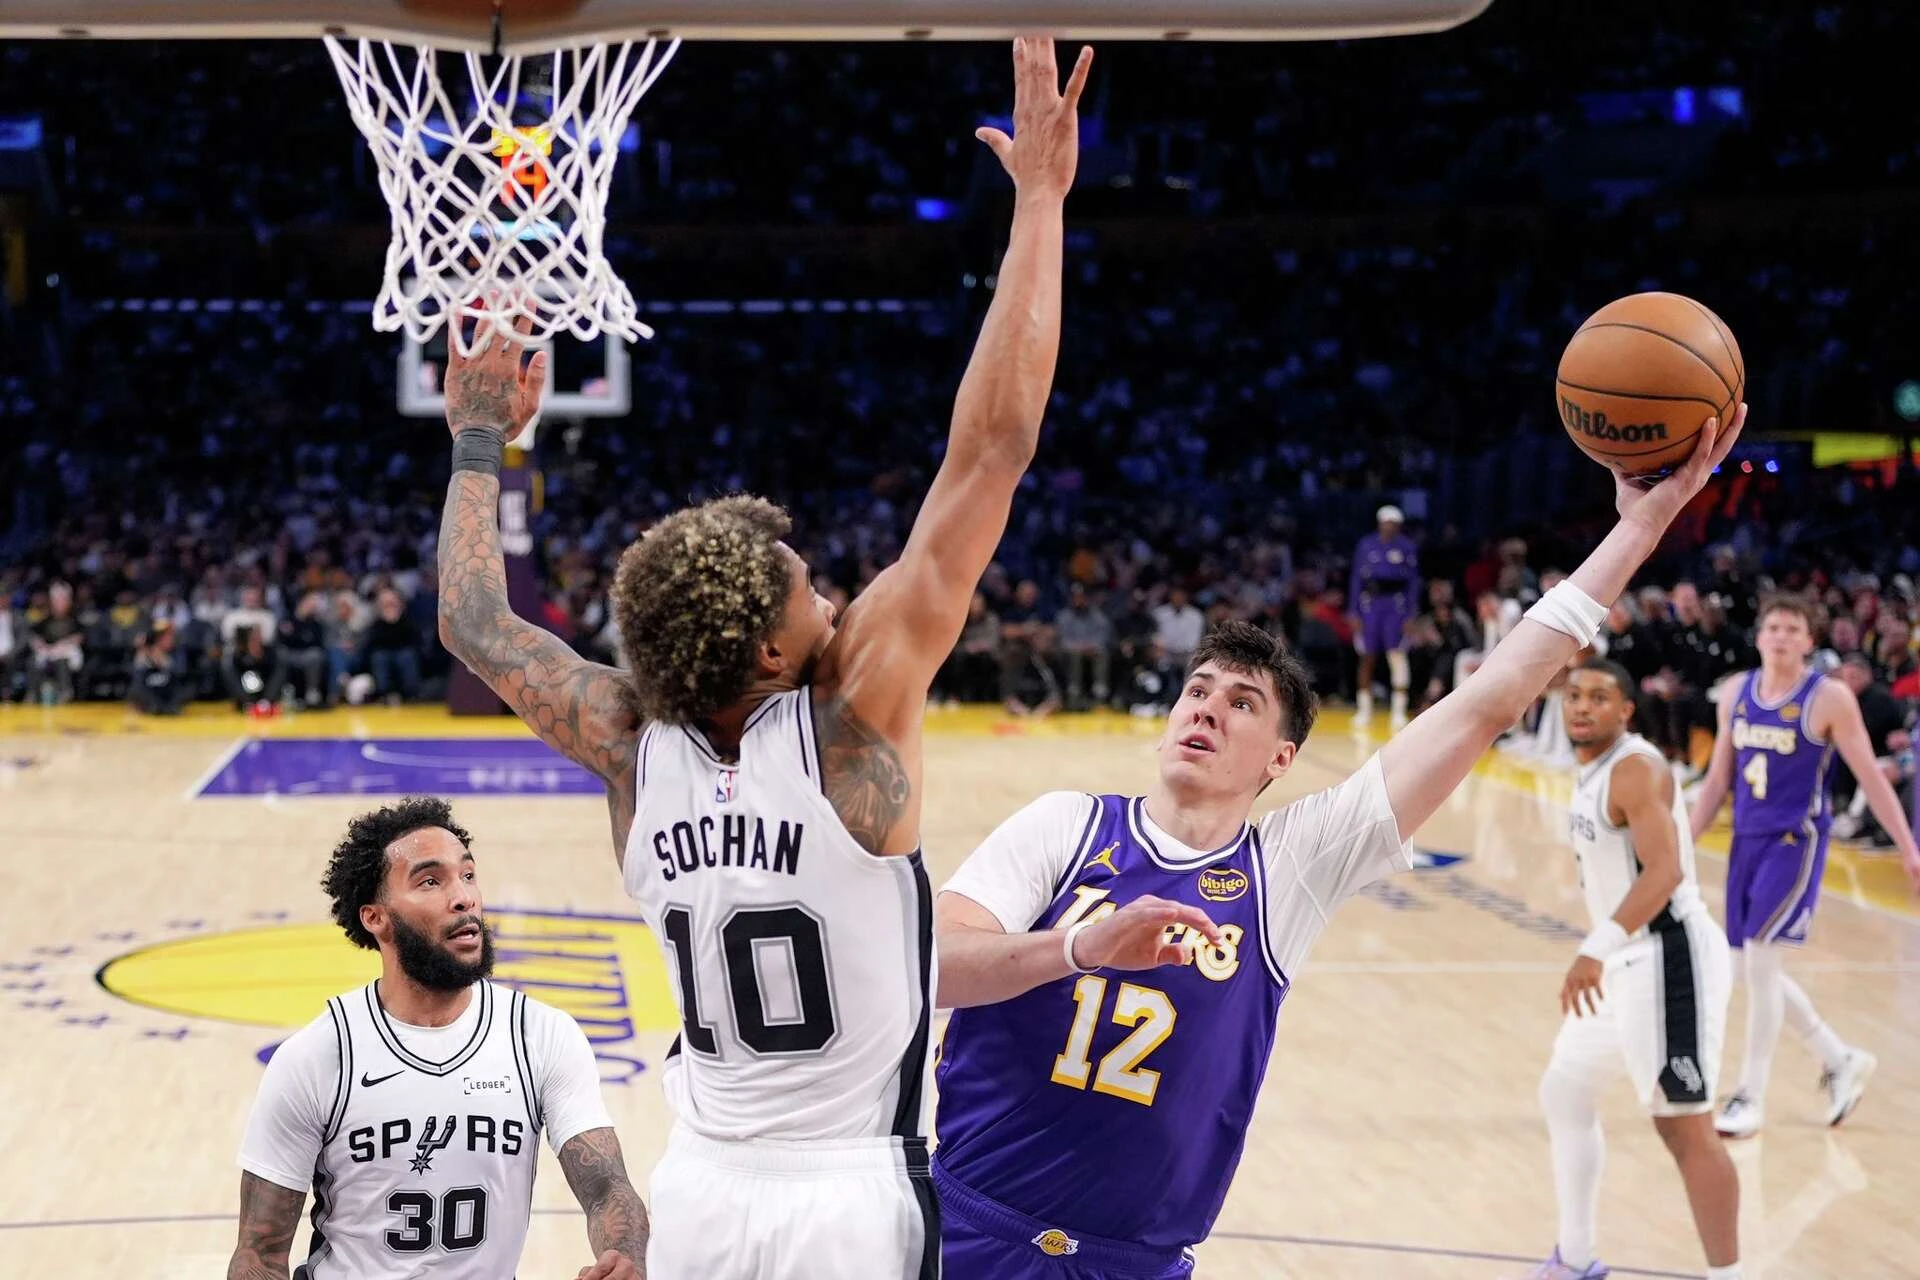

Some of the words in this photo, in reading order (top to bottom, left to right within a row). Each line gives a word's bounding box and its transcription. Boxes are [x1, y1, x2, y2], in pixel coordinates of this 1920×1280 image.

[1560, 395, 1668, 442] Wilson
[1743, 752, 1768, 800] 4
[653, 814, 803, 882] SOCHAN
[1201, 874, 1245, 892] bibigo
[661, 900, 842, 1062] 10
[1051, 974, 1177, 1107] 12
[469, 1080, 505, 1090] LEDGER
[384, 1184, 489, 1253] 30
